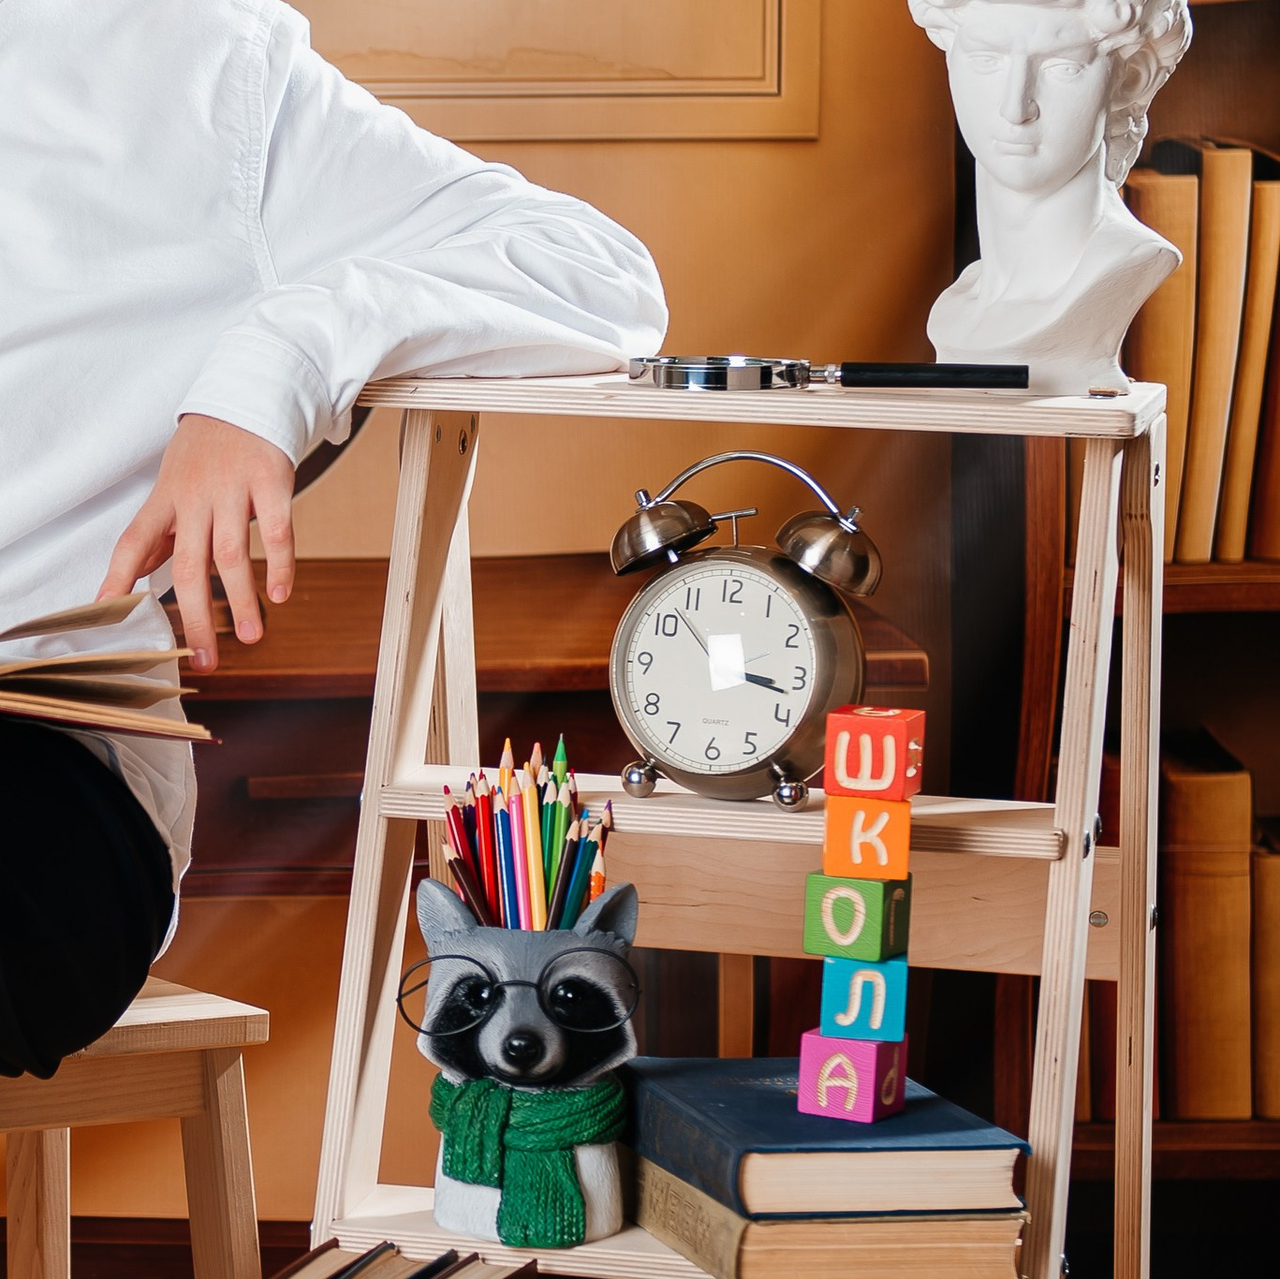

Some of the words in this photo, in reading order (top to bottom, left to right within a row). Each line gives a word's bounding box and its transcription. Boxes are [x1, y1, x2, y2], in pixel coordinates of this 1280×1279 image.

[685, 586, 701, 611] 11
[721, 579, 744, 604] 12
[654, 612, 679, 638] 10
[785, 624, 800, 649] 2
[637, 651, 654, 676] 9
[792, 666, 807, 691] 3
[643, 692, 661, 716] 8
[774, 703, 791, 728] 4
[666, 721, 682, 745] 7
[742, 731, 758, 756] 5
[704, 737, 721, 761] 6
